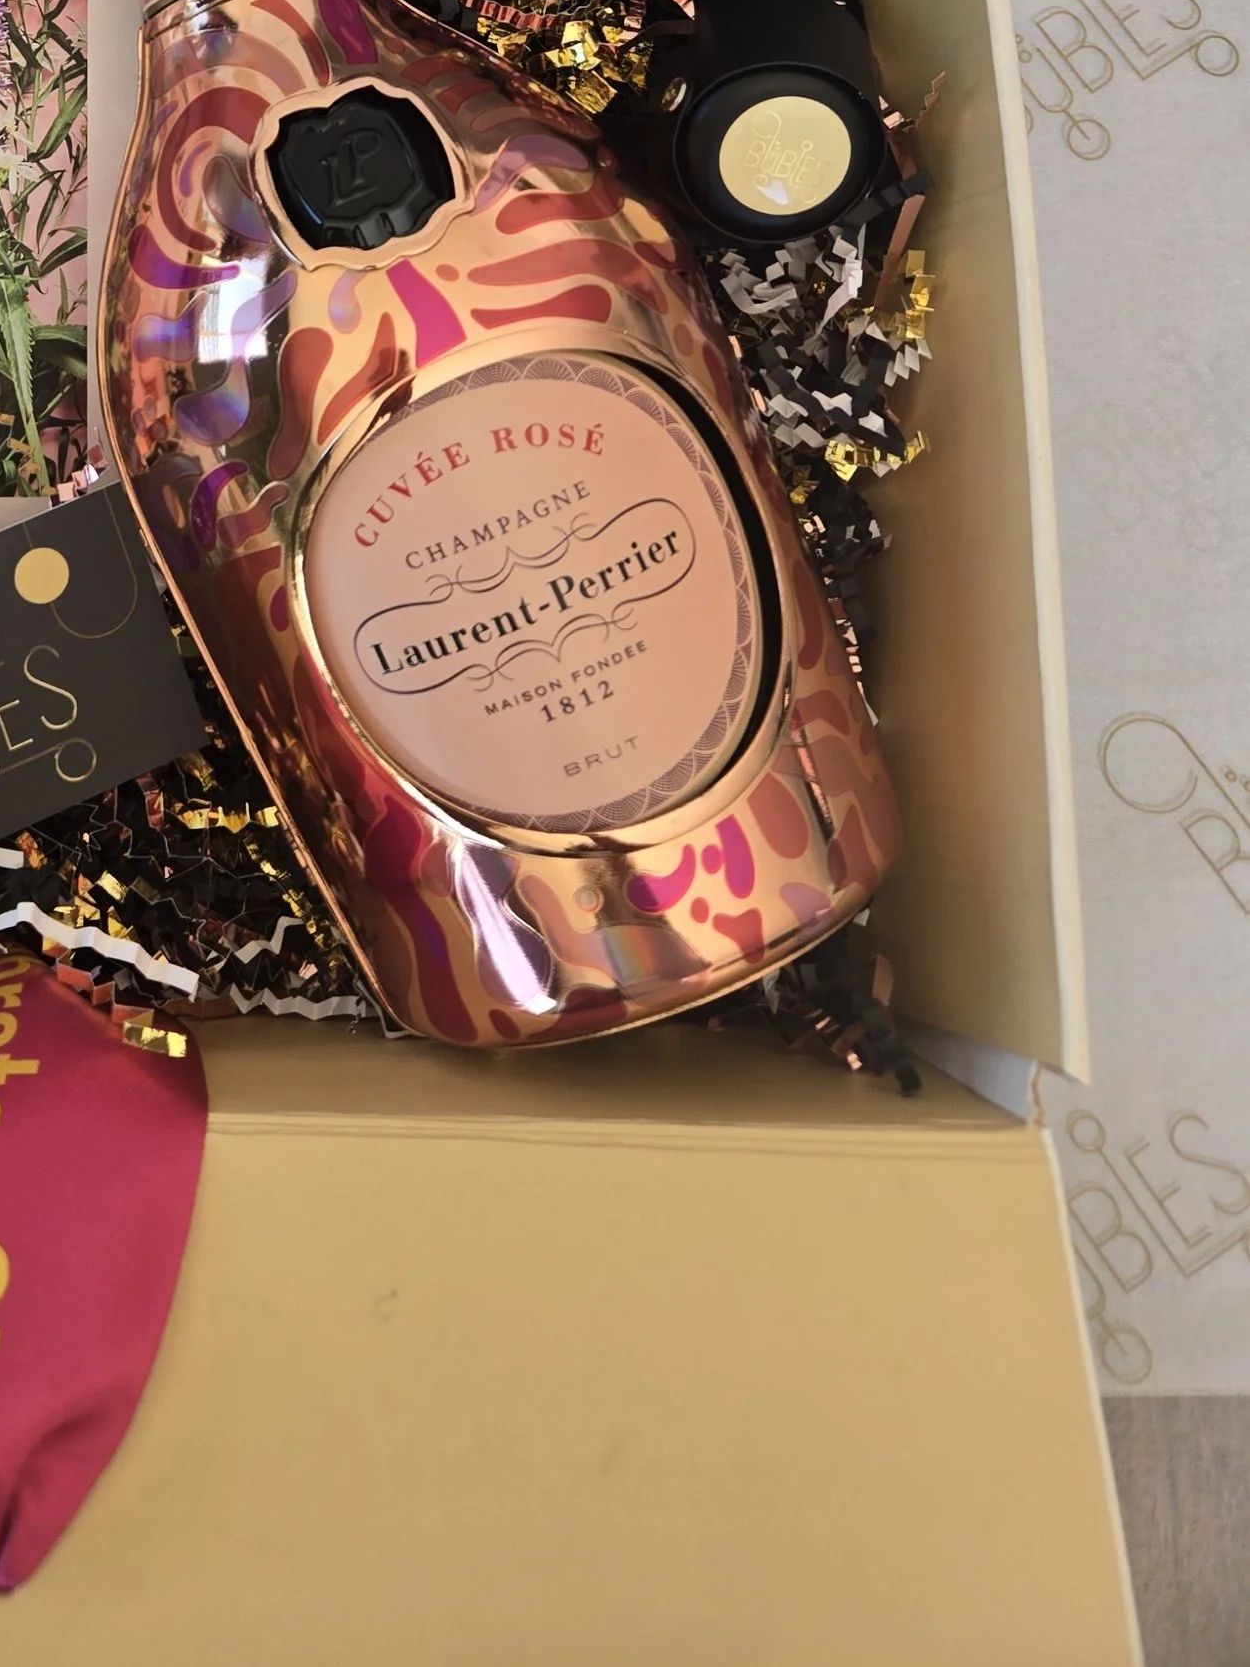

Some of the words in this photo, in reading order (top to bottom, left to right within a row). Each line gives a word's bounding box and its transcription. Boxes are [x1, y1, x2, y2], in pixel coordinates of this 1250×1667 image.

[353, 441, 471, 550] CUVÉE
[489, 421, 608, 458] ROSÉ
[404, 479, 592, 571] CHAMPAGNE
[370, 526, 681, 677] Laurent-Perrier
[483, 677, 564, 717] MAISON
[570, 639, 649, 681] FONDÉE
[539, 679, 617, 724] 1812
[562, 735, 641, 779] BRUT
